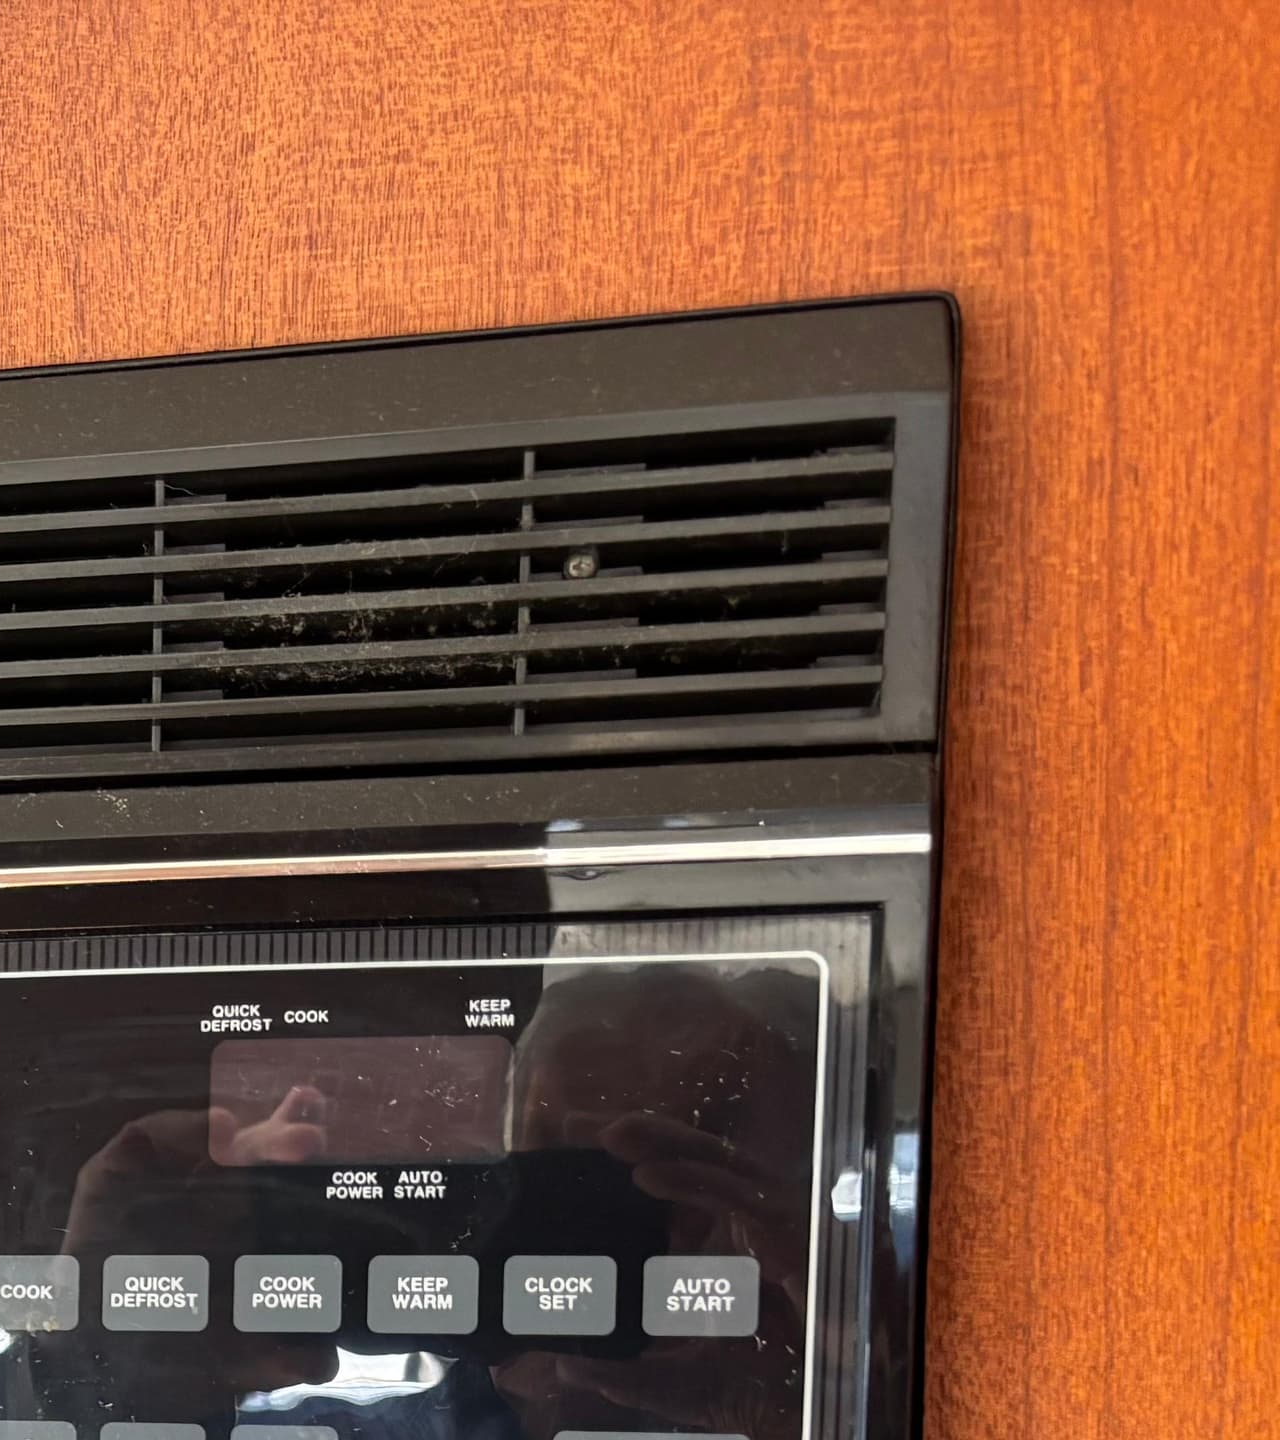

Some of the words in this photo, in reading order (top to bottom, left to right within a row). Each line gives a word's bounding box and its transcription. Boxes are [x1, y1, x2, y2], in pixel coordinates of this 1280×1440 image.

[212, 1005, 261, 1019] QUICK
[469, 1000, 511, 1014] KEEP
[200, 1018, 273, 1032] DEFROST
[283, 1009, 330, 1025] COOK
[465, 1014, 515, 1027] WARM
[331, 1171, 378, 1186] COOK
[398, 1170, 444, 1184] AUTO
[325, 1186, 384, 1200] POWER
[393, 1185, 446, 1199] START
[0, 1284, 54, 1301] COOK
[124, 1276, 185, 1294] QUICK
[259, 1276, 317, 1294] COOK
[396, 1277, 449, 1294] KEEP
[524, 1277, 593, 1295] CLOCK
[672, 1279, 731, 1296] AUTO
[110, 1292, 199, 1309] DEFROST
[251, 1292, 322, 1310] POWER
[391, 1293, 453, 1311] WARM
[538, 1295, 578, 1311] SET
[666, 1295, 735, 1312] START
